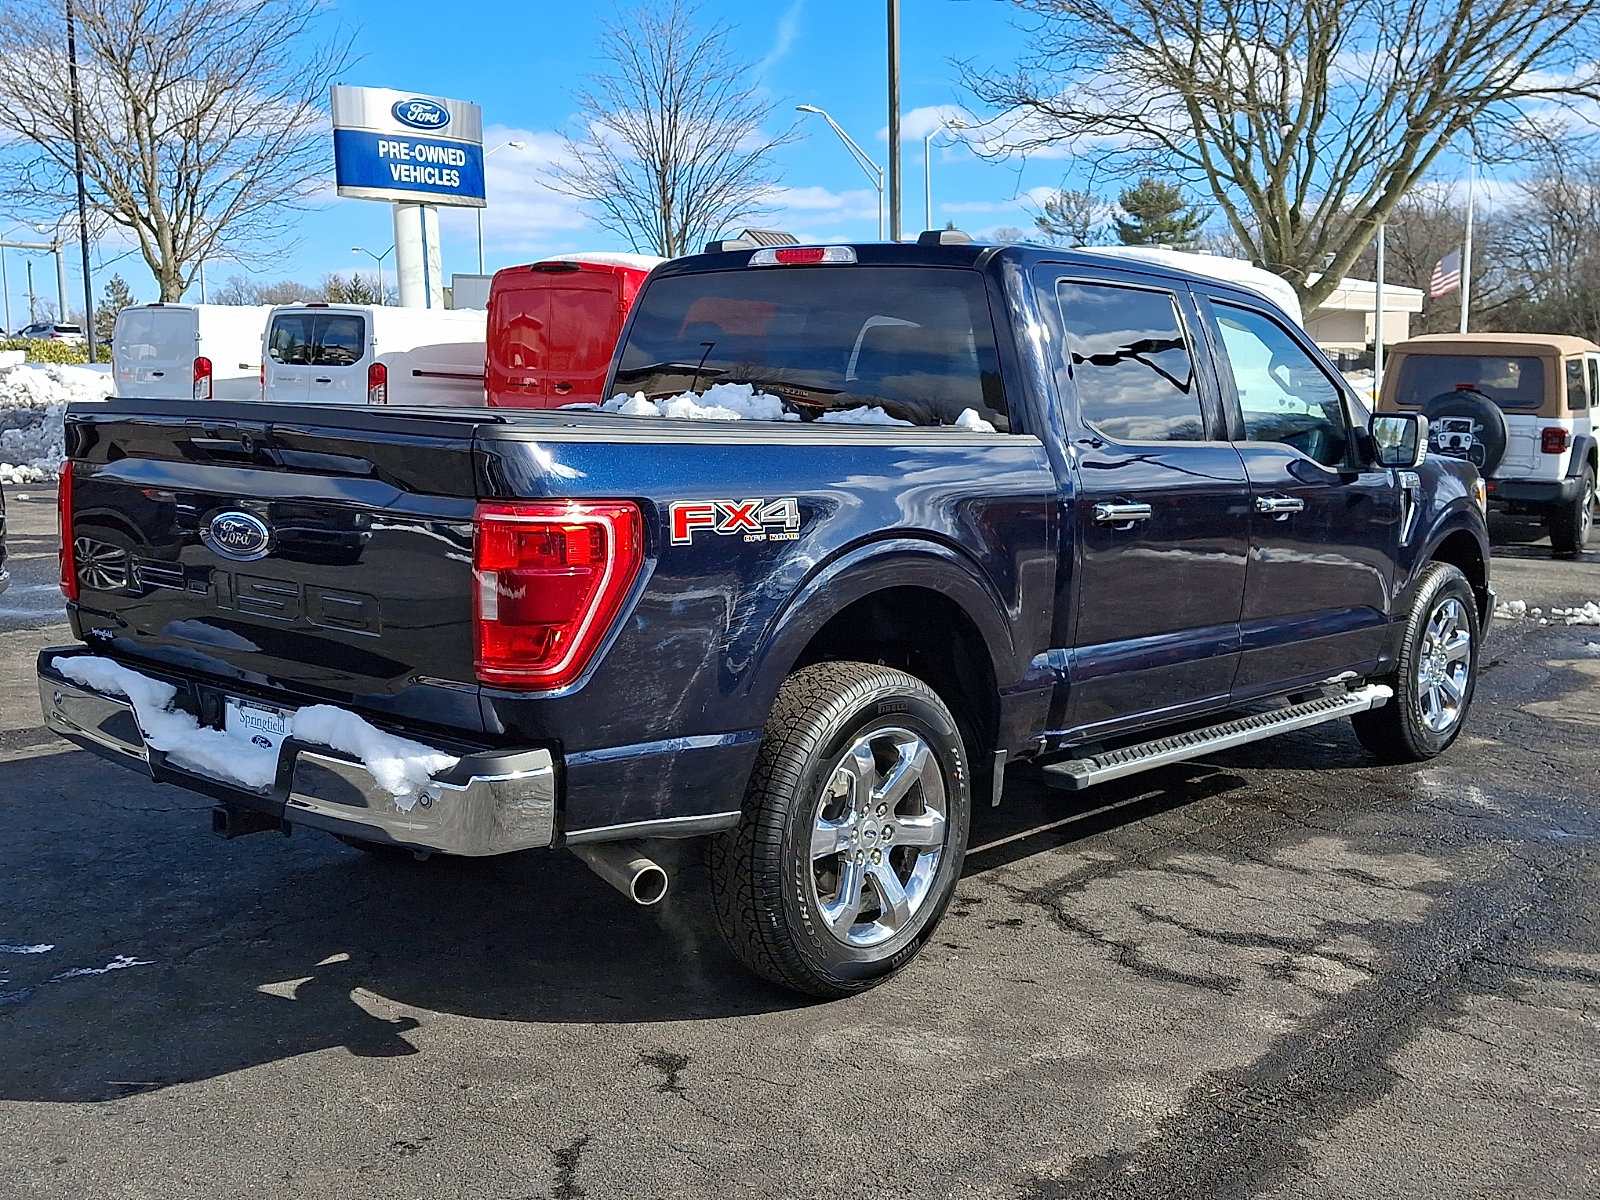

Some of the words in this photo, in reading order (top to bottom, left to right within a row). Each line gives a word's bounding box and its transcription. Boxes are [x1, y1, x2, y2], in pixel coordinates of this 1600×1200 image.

[406, 103, 440, 123] Ford
[378, 140, 466, 166] PRE-OWNED
[390, 163, 460, 187] VEHICLES
[220, 520, 252, 545] Ford
[669, 498, 800, 546] FX4
[127, 554, 382, 638] F-150
[240, 706, 285, 735] Springfield
